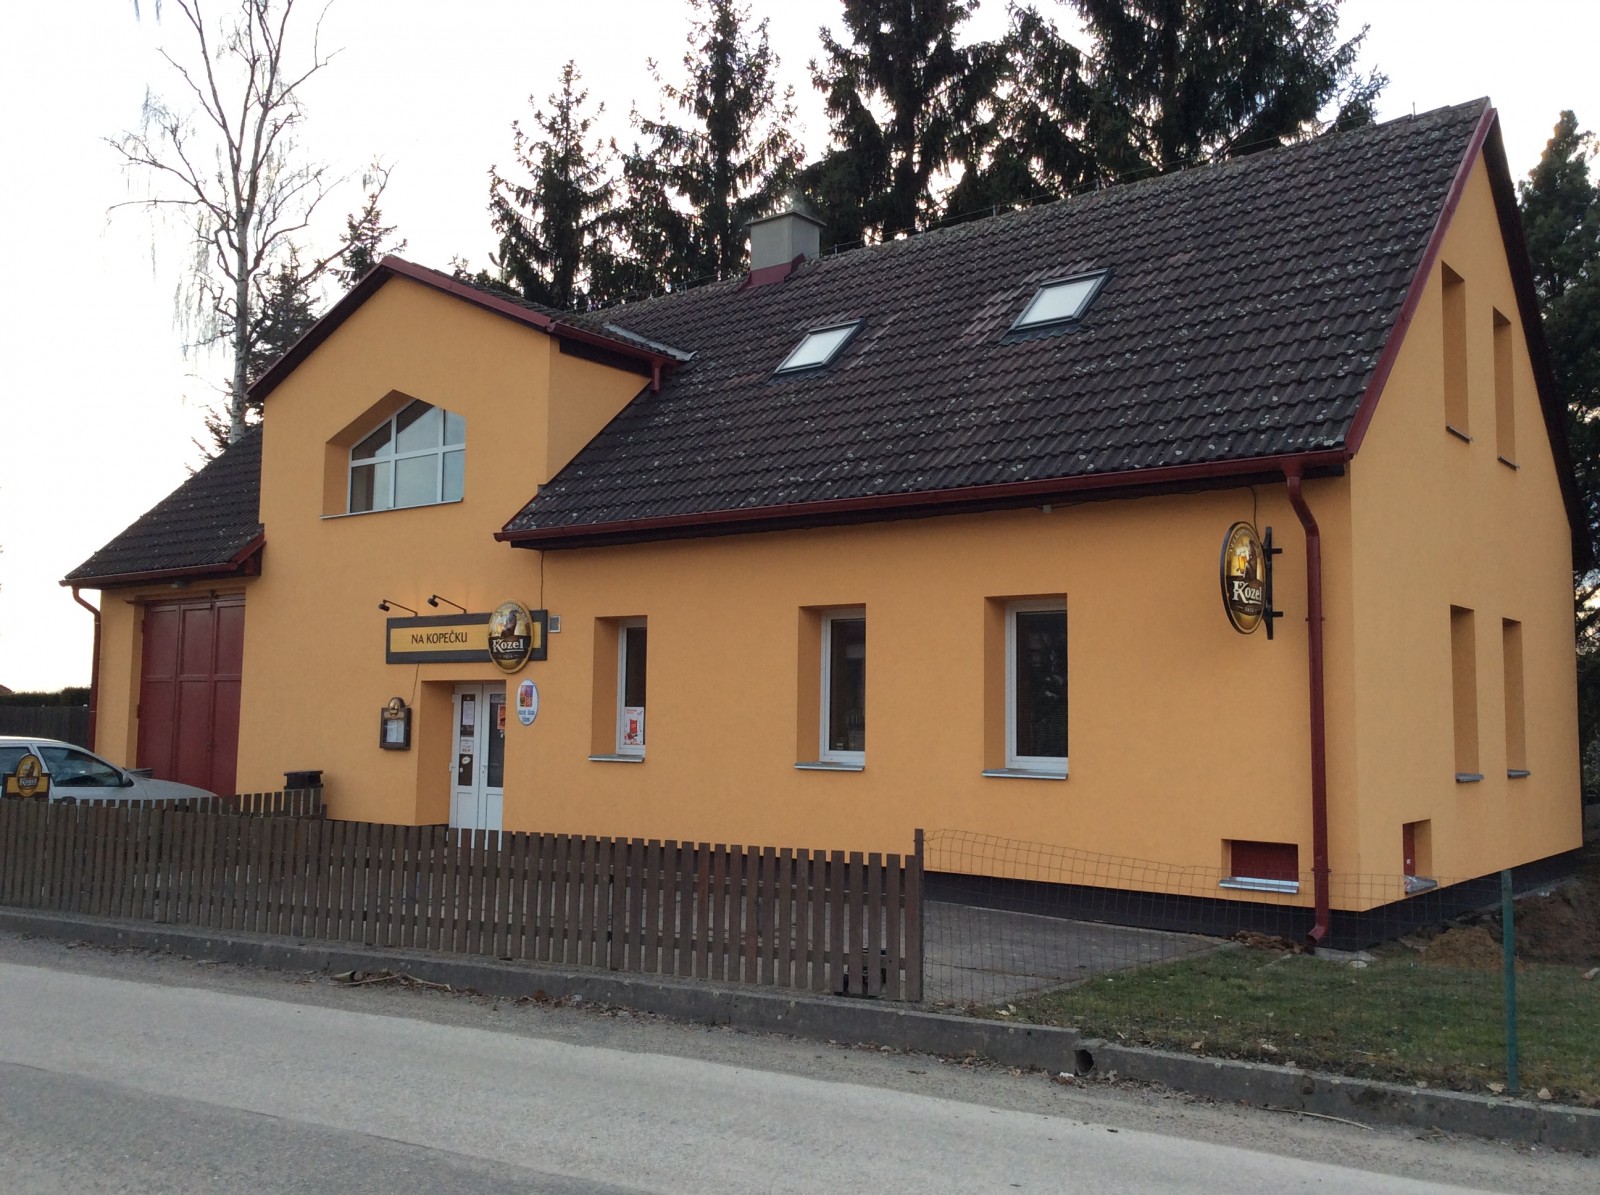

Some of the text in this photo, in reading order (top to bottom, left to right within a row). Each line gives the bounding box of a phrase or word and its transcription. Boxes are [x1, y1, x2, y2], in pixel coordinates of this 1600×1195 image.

[1232, 581, 1262, 604] Kozel
[411, 629, 468, 645] NA KOPEČKU
[492, 638, 525, 653] Kozel
